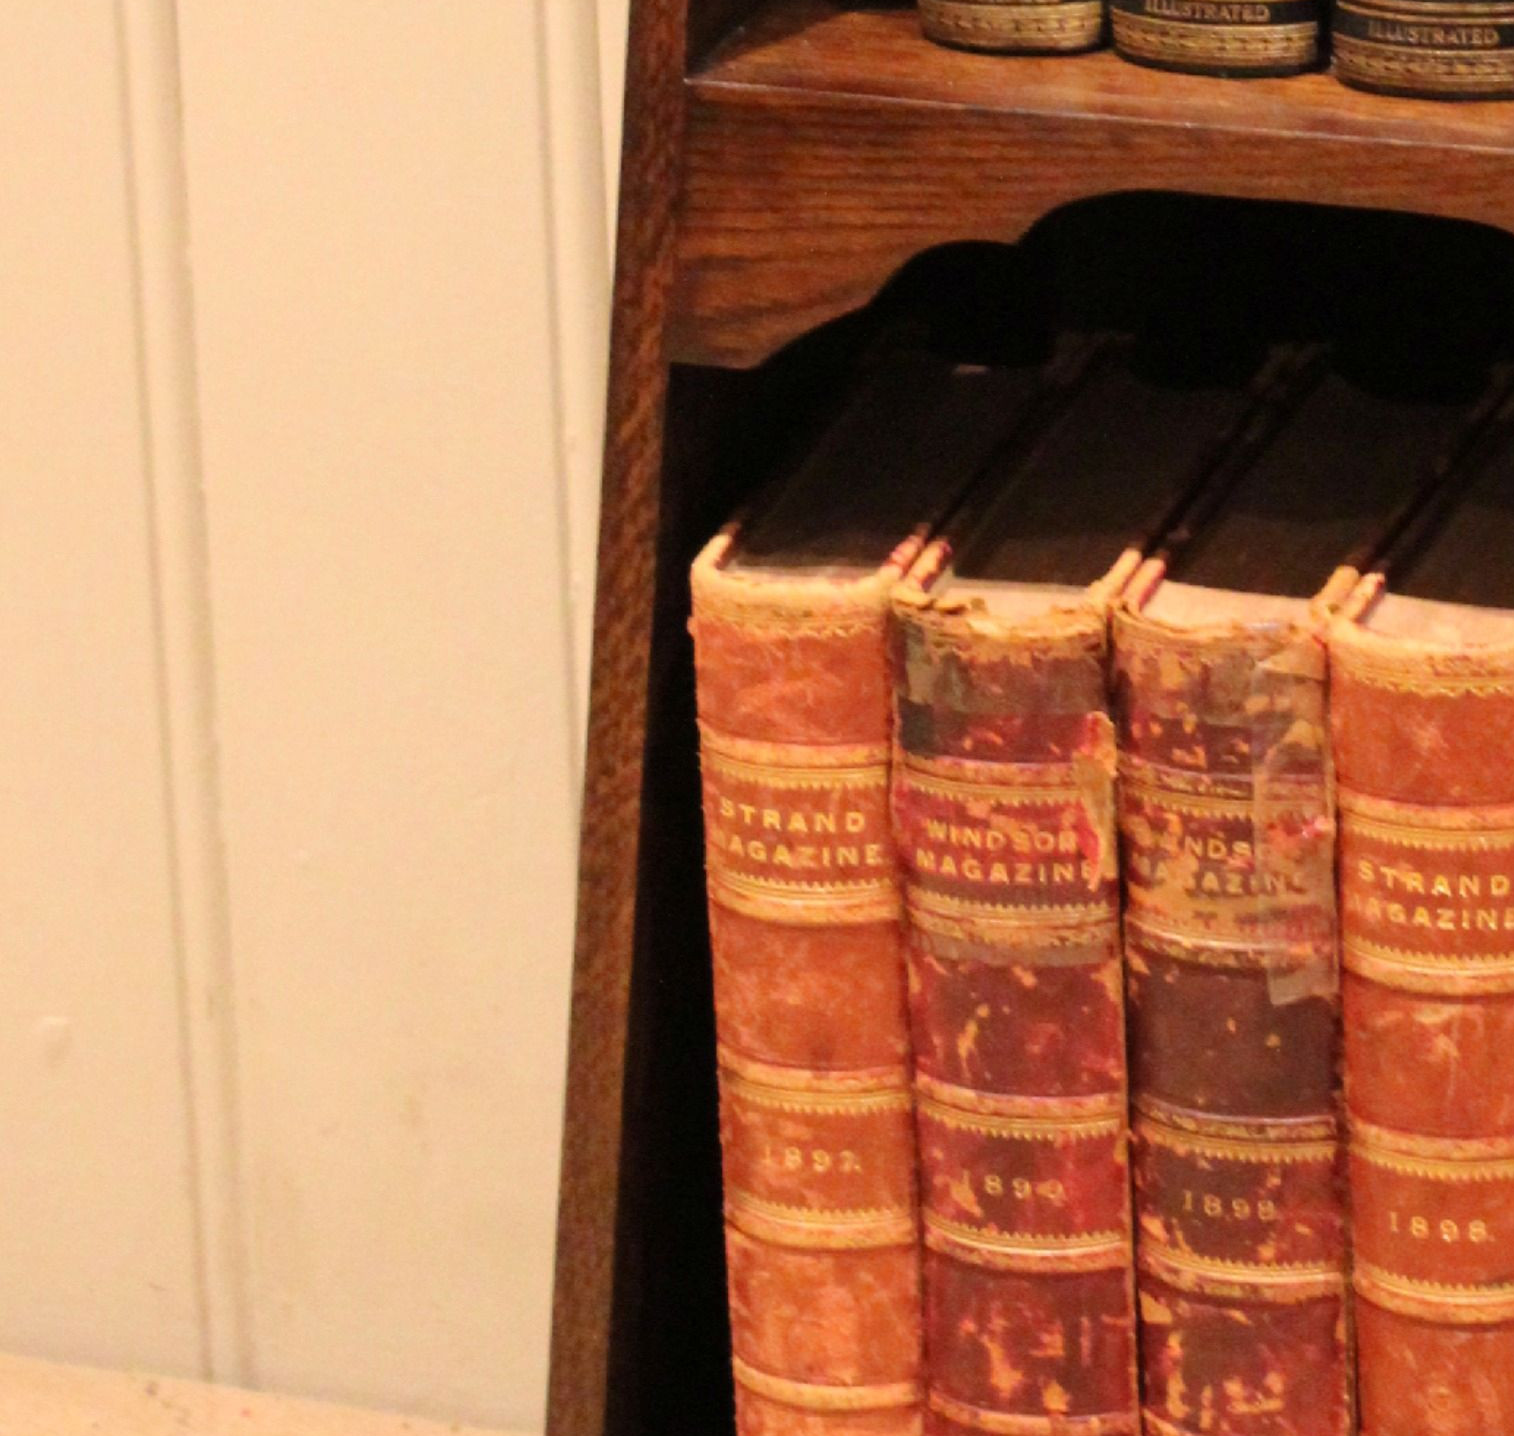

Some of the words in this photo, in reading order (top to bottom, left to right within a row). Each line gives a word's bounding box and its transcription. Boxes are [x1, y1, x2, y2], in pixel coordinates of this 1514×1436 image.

[1368, 18, 1500, 47] ILLUSTRATED
[719, 795, 867, 834] STRAND
[926, 818, 1079, 854] WINDSOR
[1357, 859, 1512, 898] STRAND
